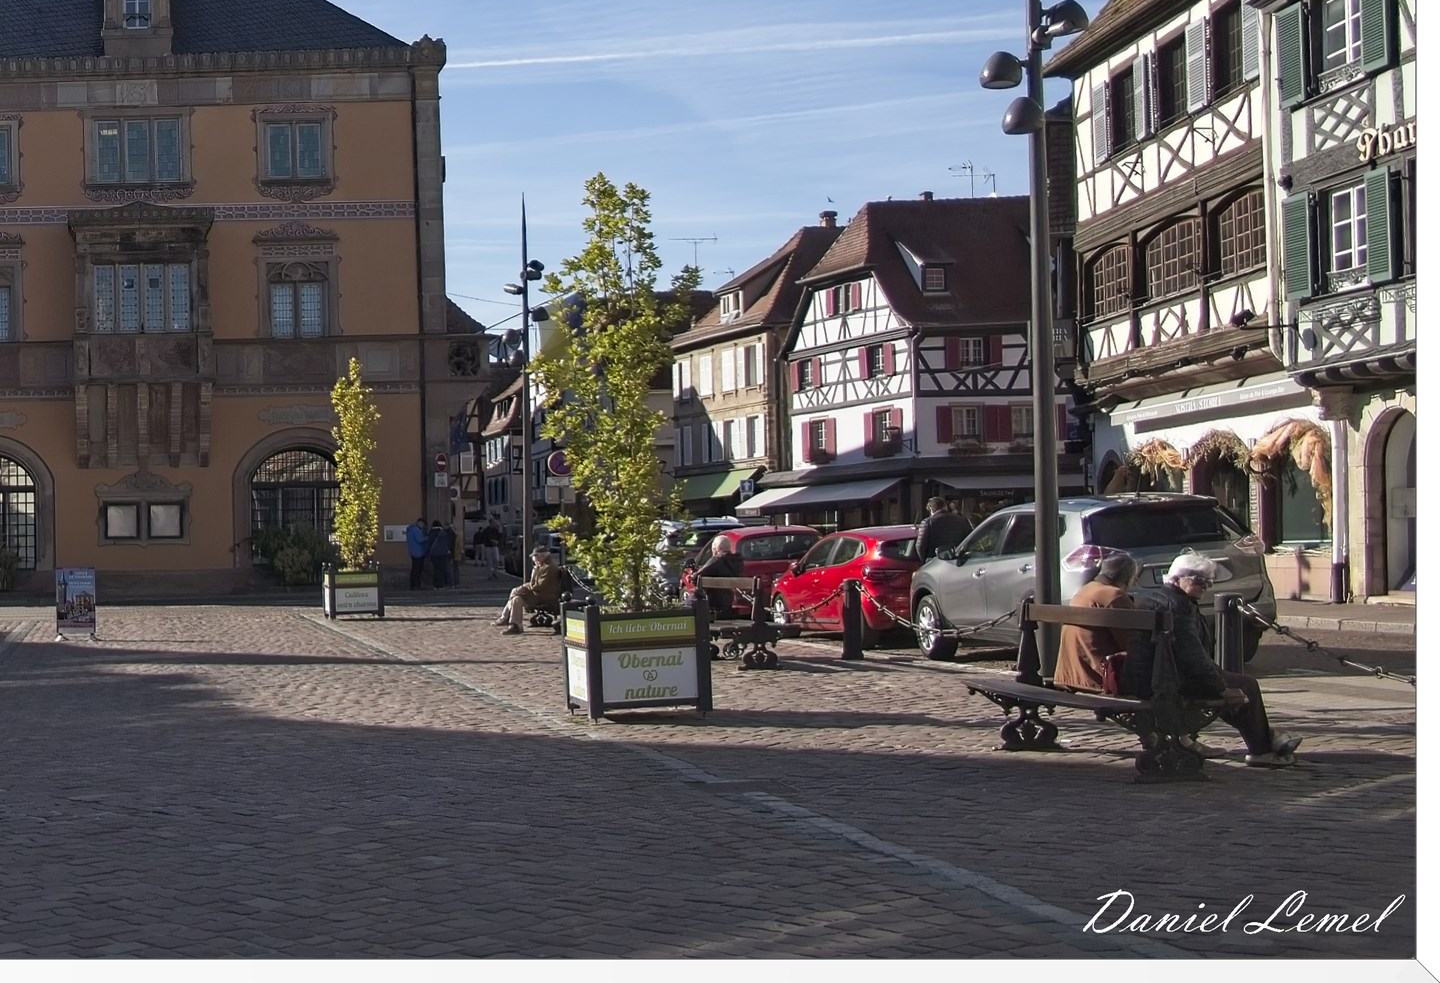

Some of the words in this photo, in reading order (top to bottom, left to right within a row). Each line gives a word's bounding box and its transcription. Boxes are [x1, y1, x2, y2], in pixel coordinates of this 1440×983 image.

[609, 625, 623, 635] Ich
[625, 623, 647, 633] liebe
[650, 620, 688, 632] Obernai
[617, 651, 684, 670] Obernai
[624, 684, 679, 700] nature
